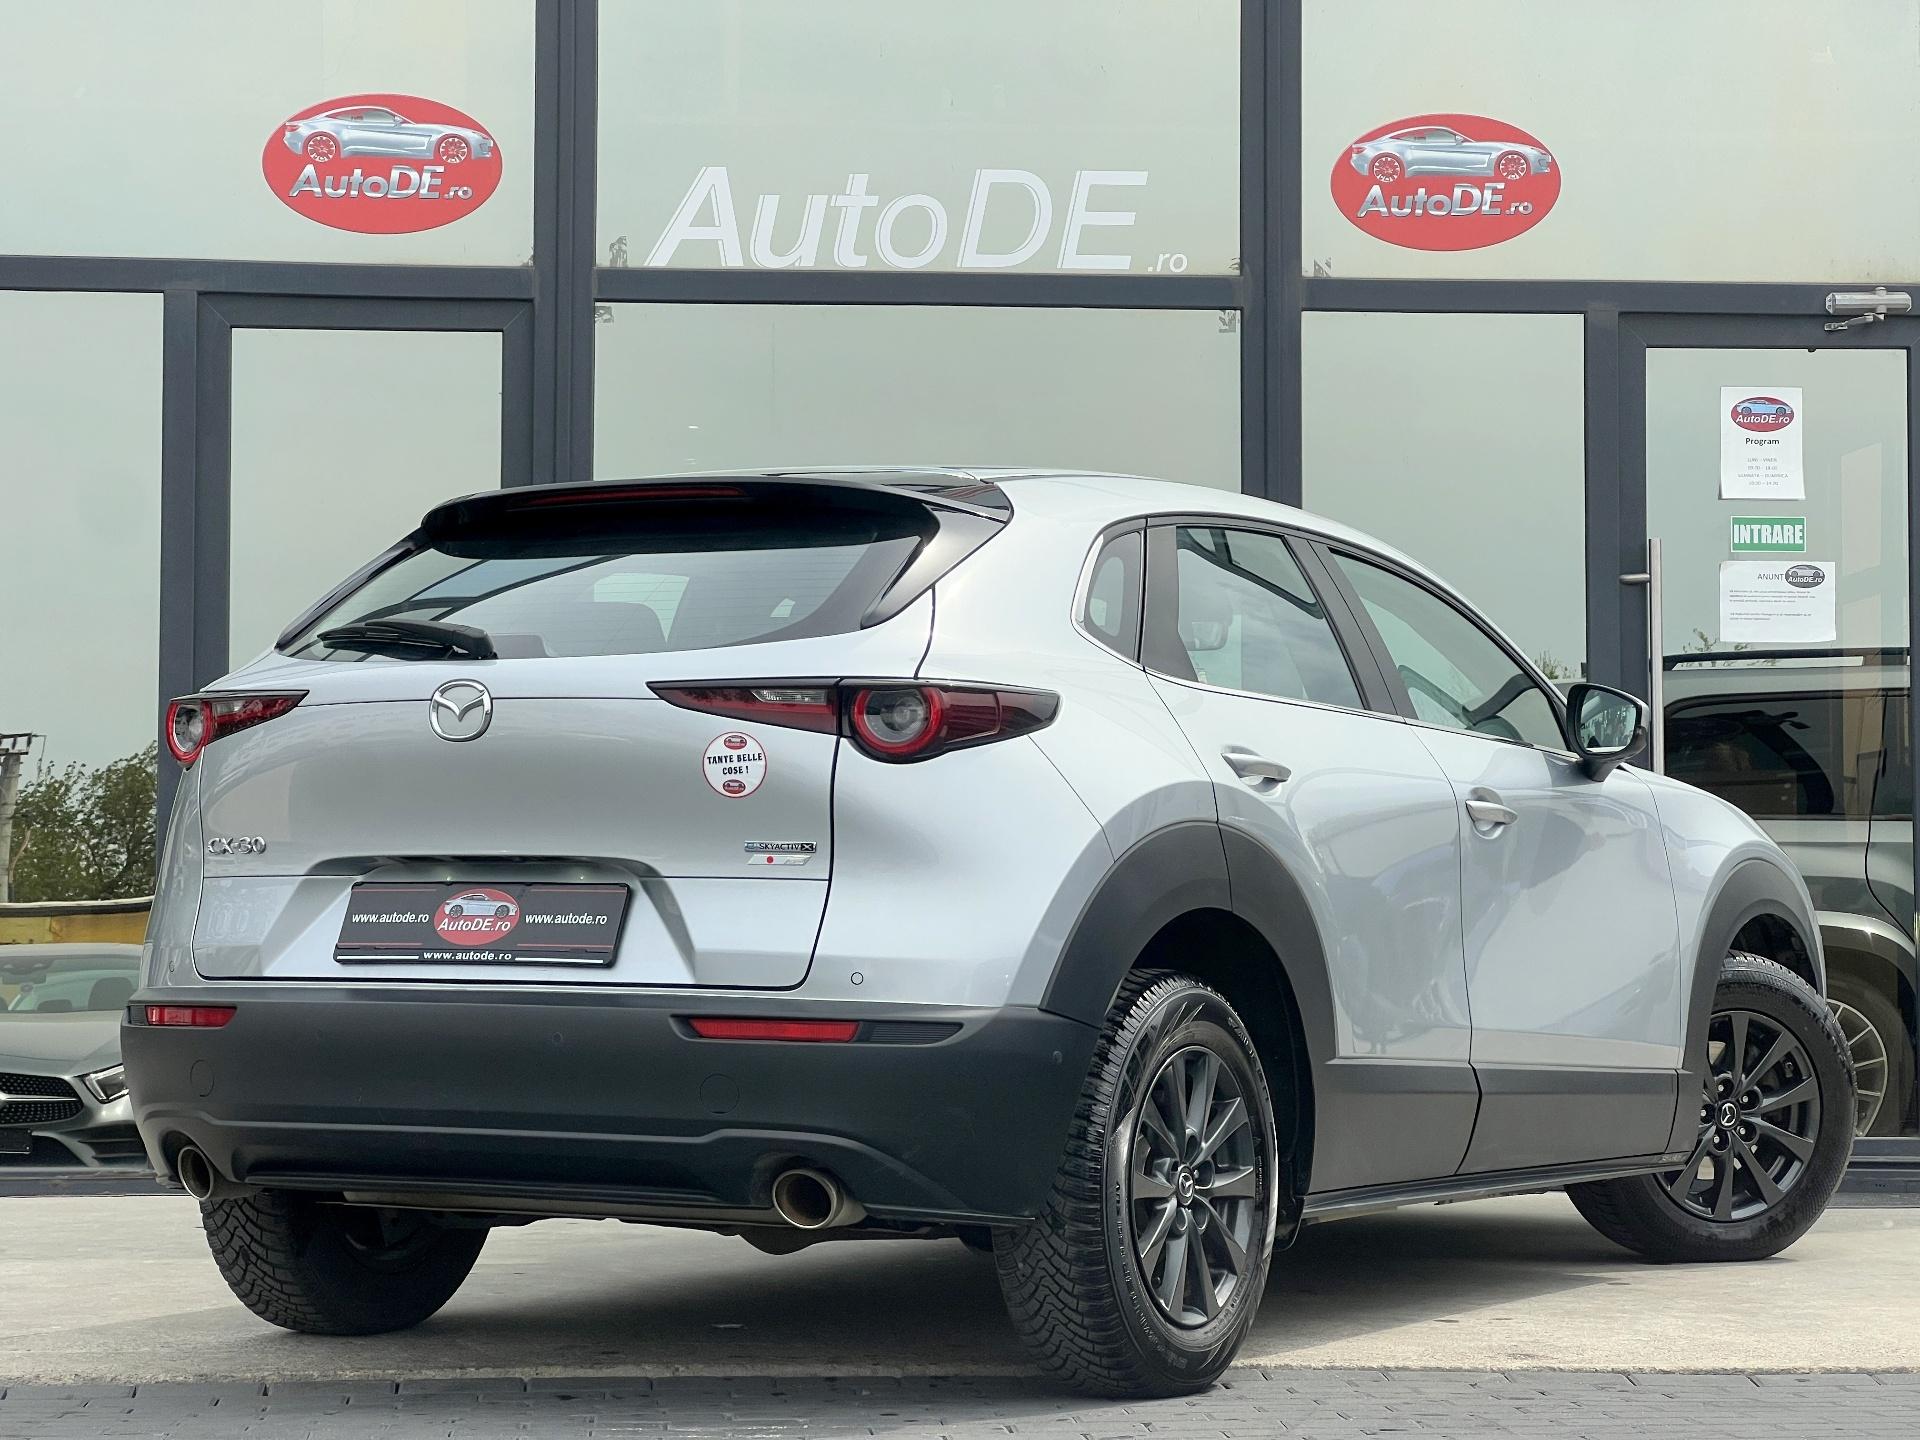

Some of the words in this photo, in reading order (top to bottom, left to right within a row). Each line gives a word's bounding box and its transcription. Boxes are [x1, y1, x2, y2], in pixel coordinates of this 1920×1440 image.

[288, 163, 473, 200] AutoDE.ro
[1356, 182, 1533, 218] AutoDE.ro
[1736, 414, 1790, 424] AutoDE.ro
[1745, 437, 1780, 447] Program
[1733, 524, 1804, 544] INTRARE
[1757, 573, 1785, 581] ANUNT
[707, 754, 734, 765] TANTE
[737, 752, 763, 763] BELLE
[722, 765, 744, 775] COSE
[207, 836, 266, 855] CX-30
[351, 911, 430, 924] www.autode.ro
[524, 912, 608, 926] www.autode.ro
[436, 918, 512, 933] AutoDE.ro
[422, 950, 513, 962] www.autode.ro
